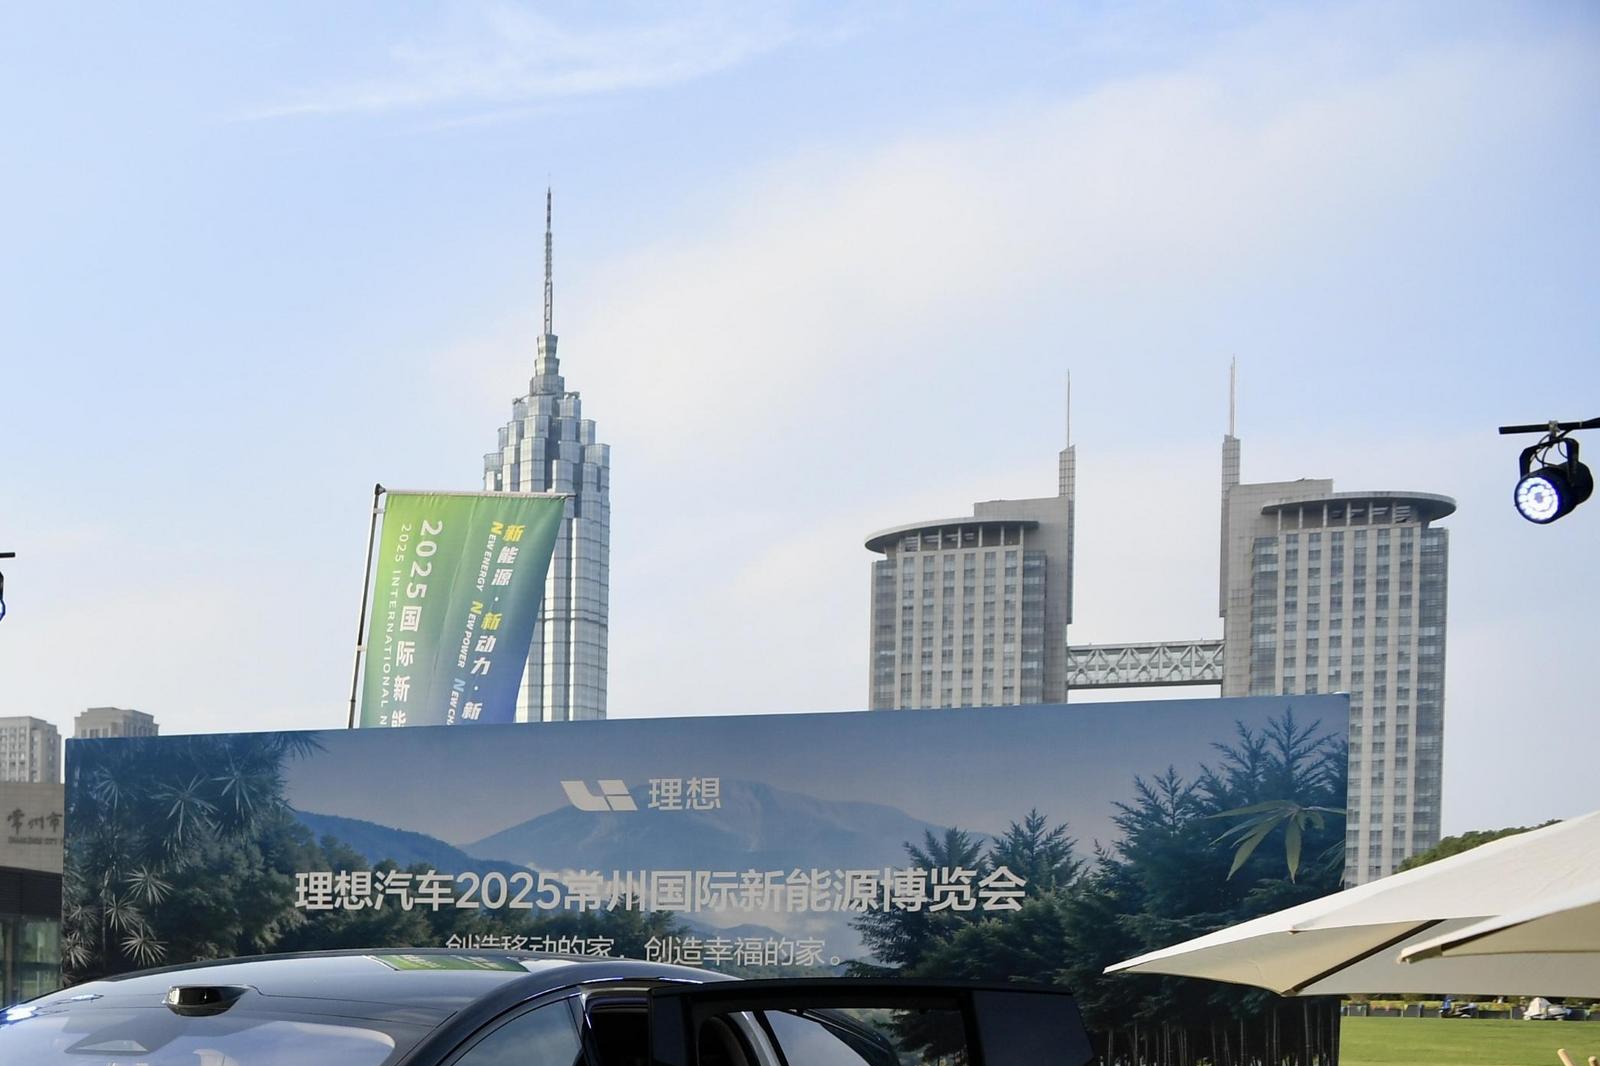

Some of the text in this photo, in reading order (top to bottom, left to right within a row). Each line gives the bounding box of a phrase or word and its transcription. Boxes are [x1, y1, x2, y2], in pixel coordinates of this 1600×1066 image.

[395, 523, 412, 562] 2025
[380, 570, 405, 708] INTERNATIONAL
[648, 777, 721, 811] 理想
[294, 867, 1028, 915] 理想汽车2025常州国际新能源博览会
